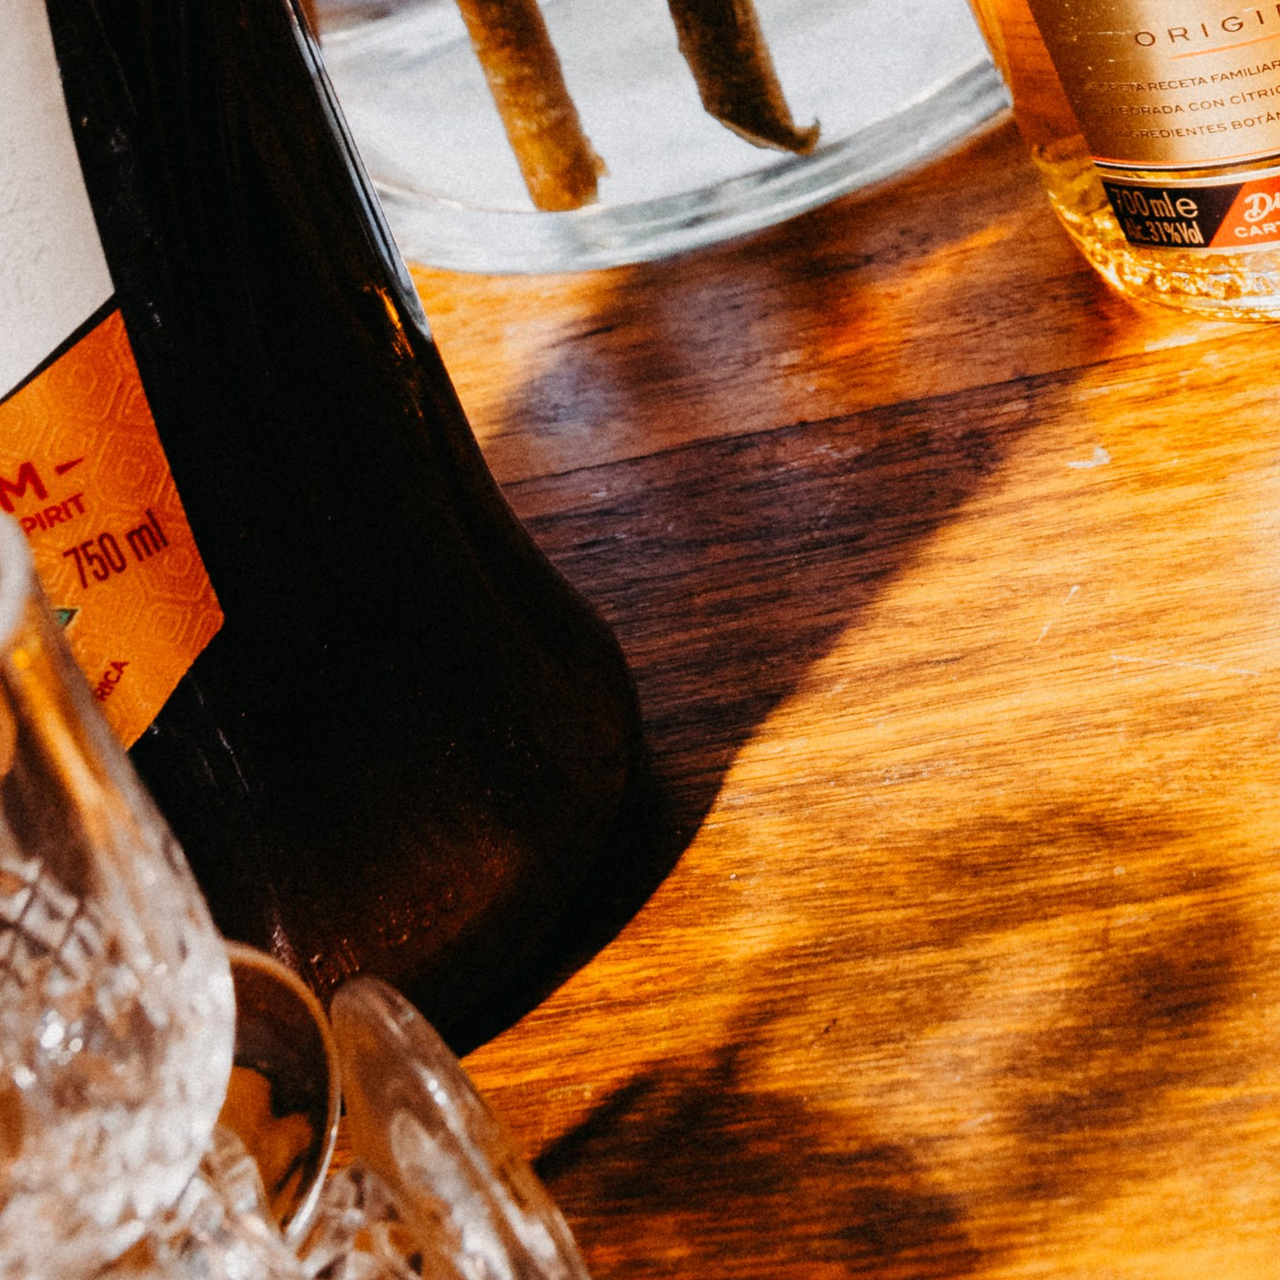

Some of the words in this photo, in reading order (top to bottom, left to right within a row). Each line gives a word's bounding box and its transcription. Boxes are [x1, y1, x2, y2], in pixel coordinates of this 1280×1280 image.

[1147, 76, 1209, 92] RECETA
[1188, 97, 1226, 113] CON
[19, 491, 86, 536] PIRIT
[62, 531, 127, 591] 750
[124, 507, 169, 564] ml
